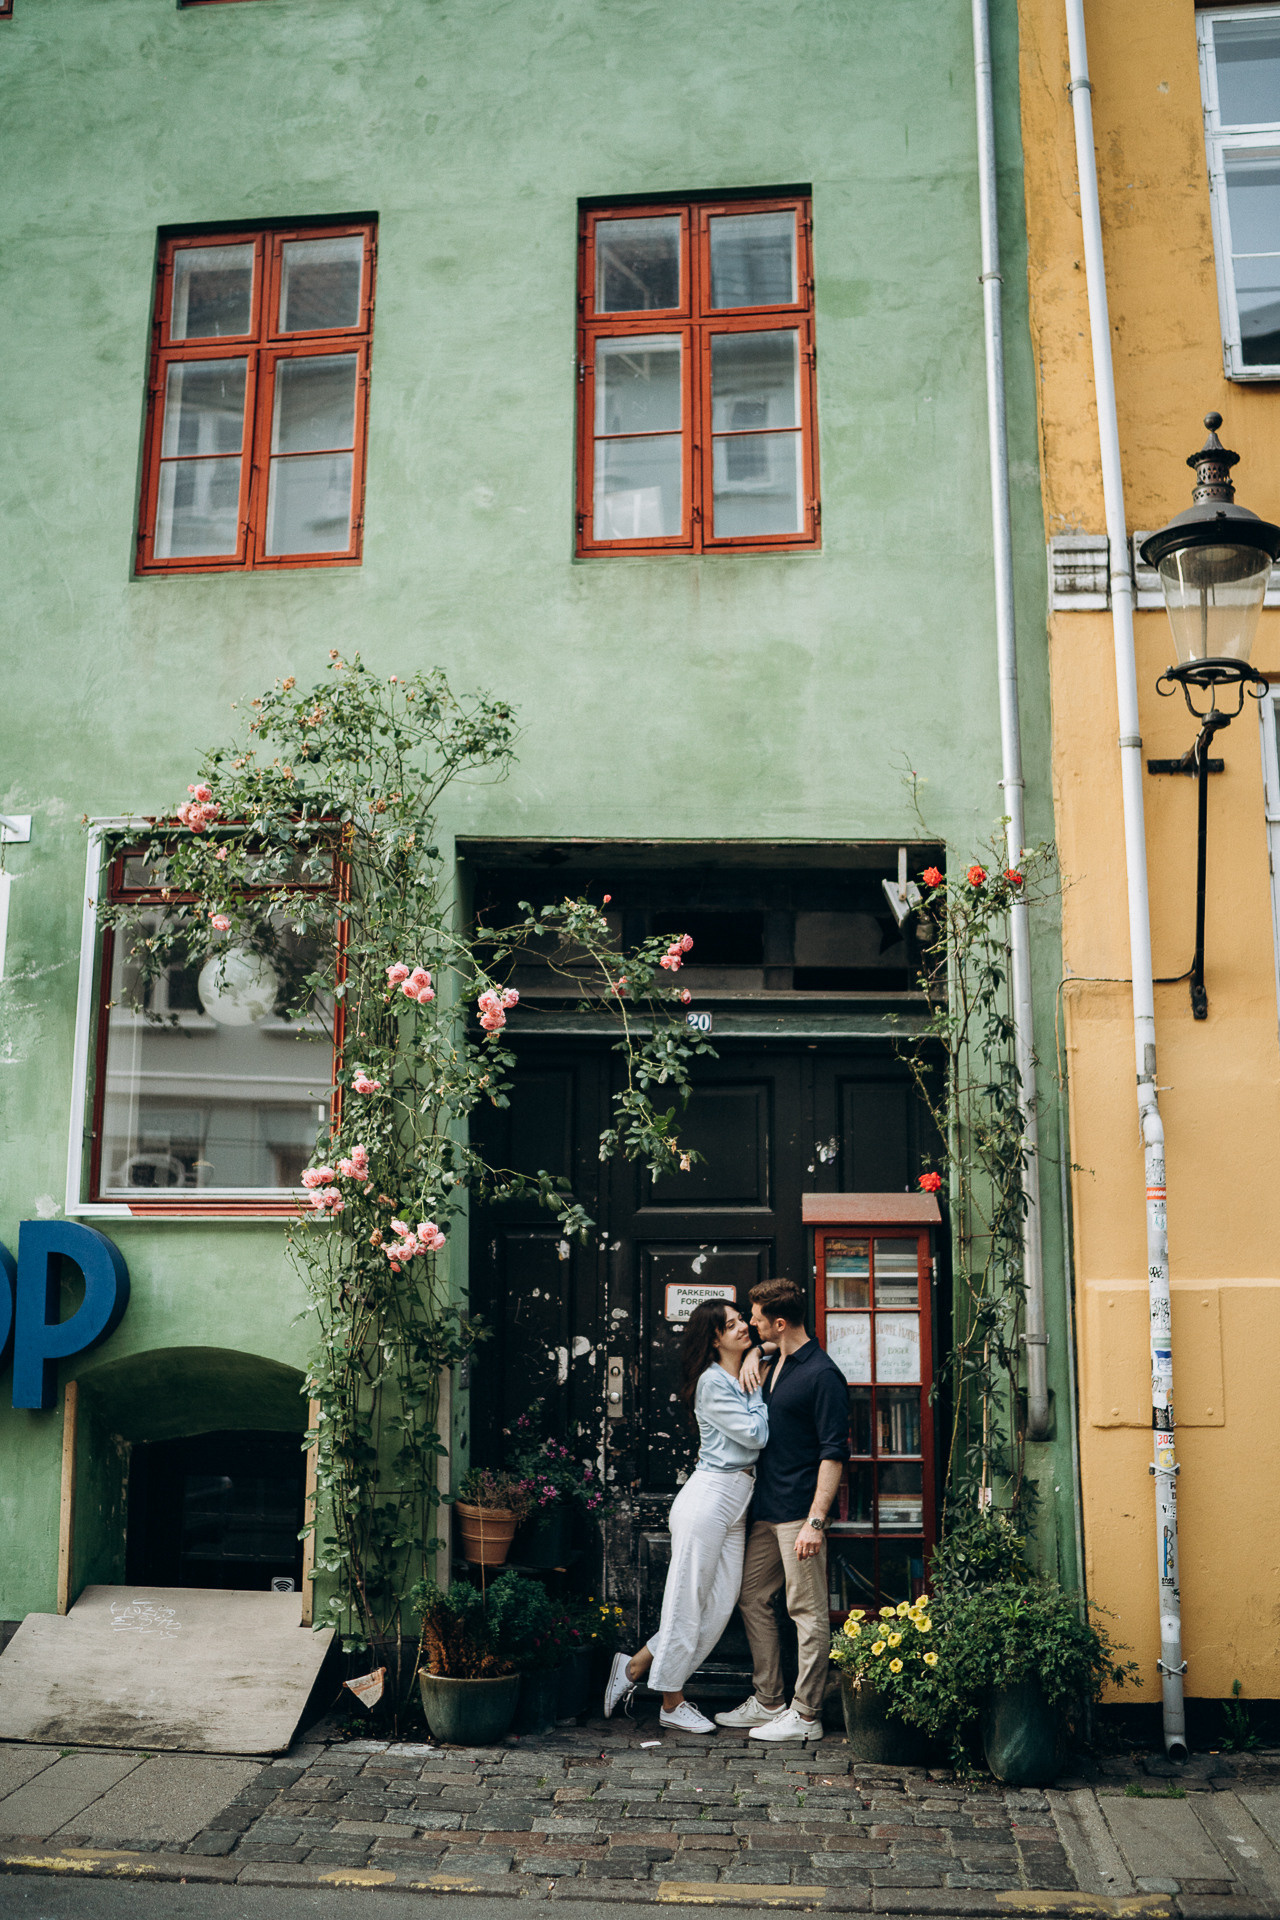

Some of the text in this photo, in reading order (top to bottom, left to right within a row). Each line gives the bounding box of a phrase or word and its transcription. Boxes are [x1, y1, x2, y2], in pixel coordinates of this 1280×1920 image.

[688, 1014, 709, 1030] 20
[677, 1288, 725, 1297] PARKERING
[0, 1220, 130, 1408] P
